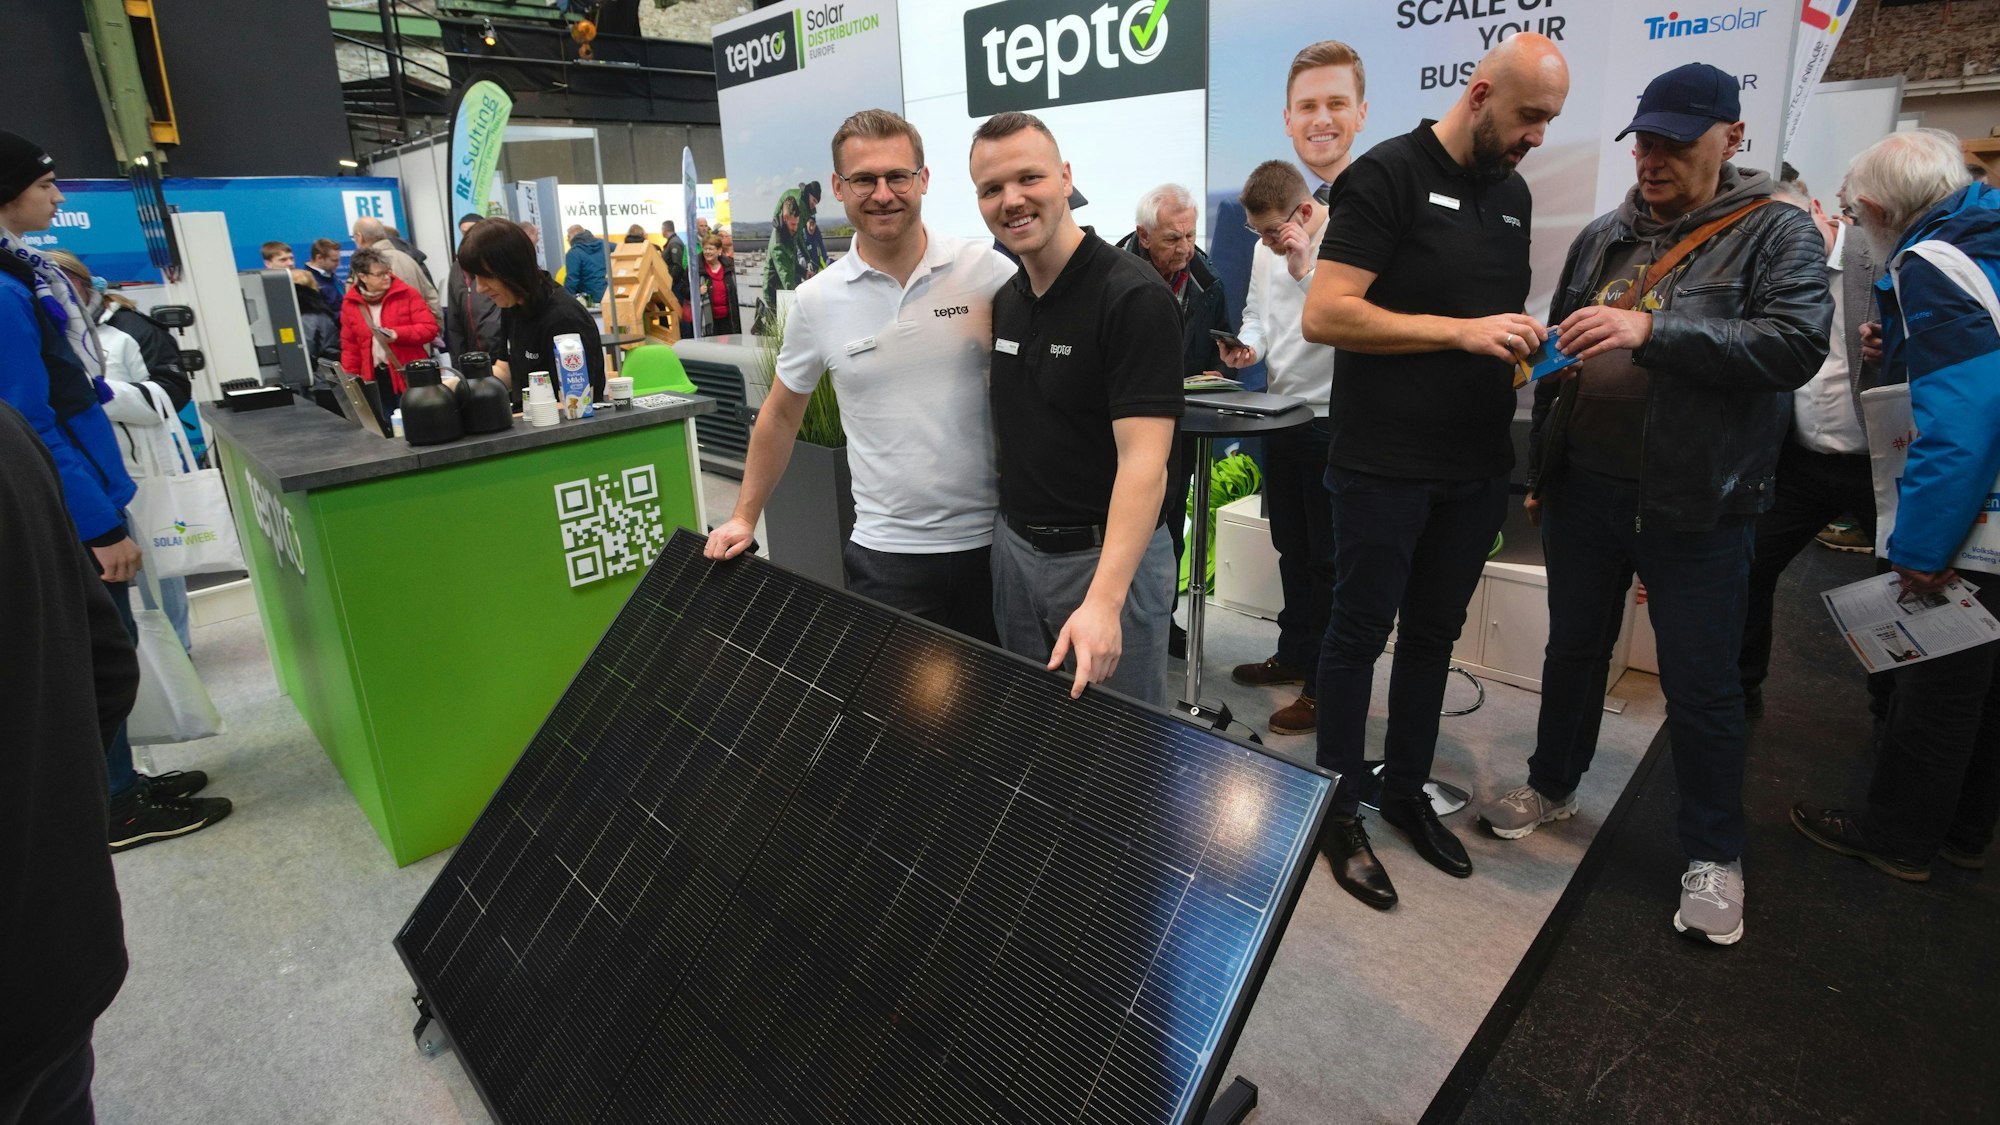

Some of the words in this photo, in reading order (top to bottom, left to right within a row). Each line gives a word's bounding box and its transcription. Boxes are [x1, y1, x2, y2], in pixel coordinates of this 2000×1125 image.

[806, 3, 844, 31] Solar
[807, 13, 879, 48] DISTRIBUTION
[1644, 7, 1767, 40] Trinasolar
[725, 30, 785, 78] tepto
[809, 44, 836, 60] EUROPE
[982, 0, 1169, 100] tepto
[1420, 60, 1480, 90] BUS
[456, 95, 499, 201] RE-Sulting
[355, 196, 383, 218] RE
[934, 305, 969, 319] tepto
[1050, 343, 1073, 358] tepto
[1961, 551, 1997, 565] Oberberg
